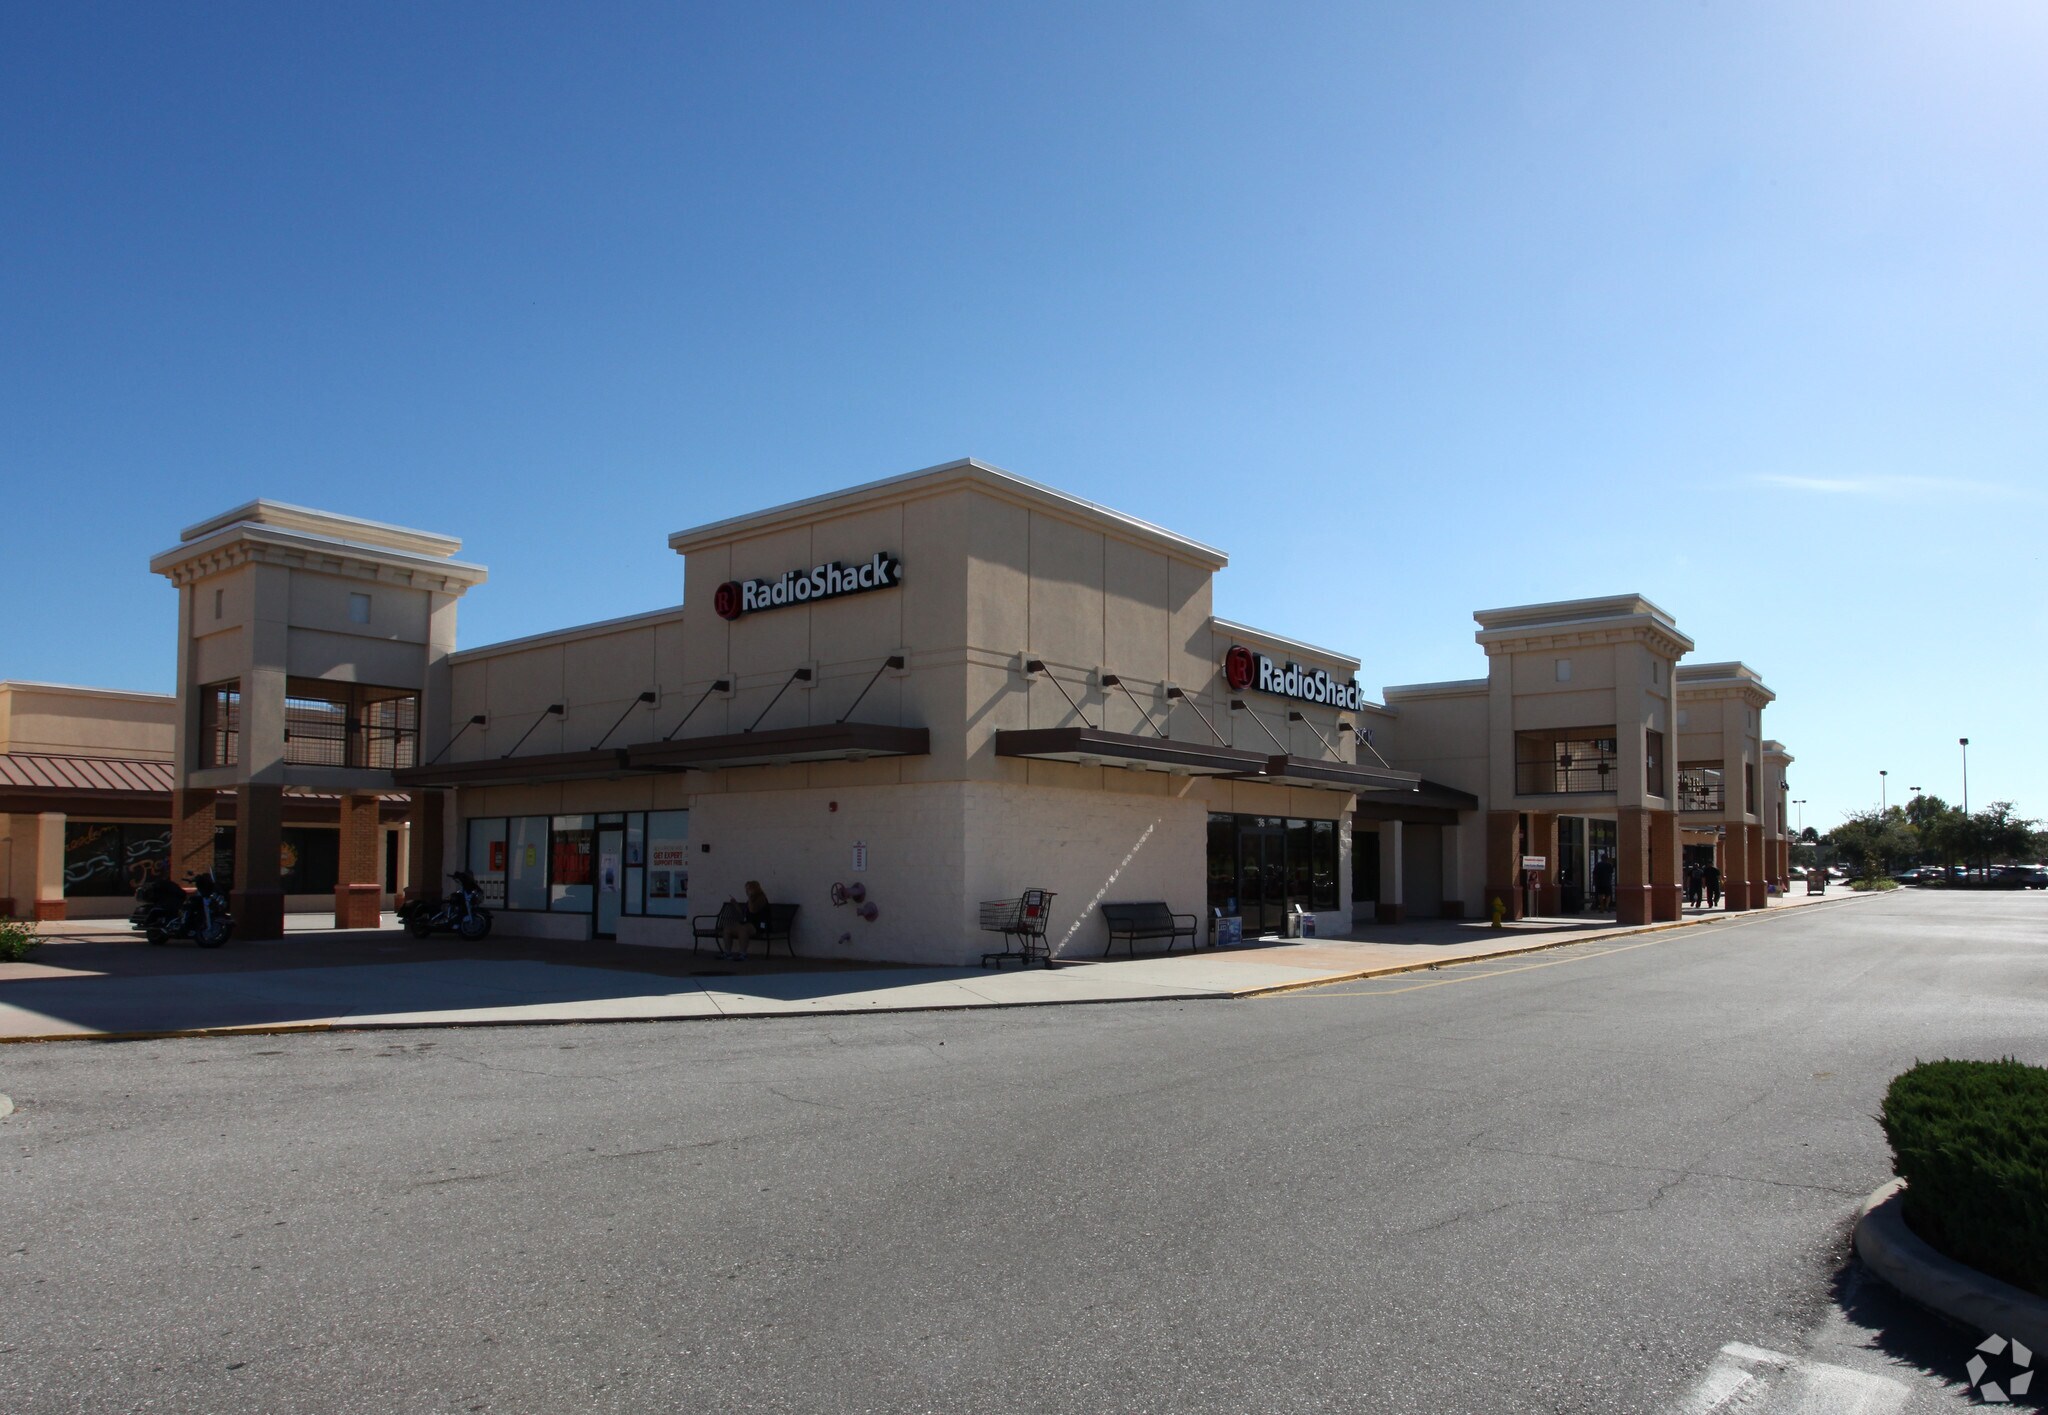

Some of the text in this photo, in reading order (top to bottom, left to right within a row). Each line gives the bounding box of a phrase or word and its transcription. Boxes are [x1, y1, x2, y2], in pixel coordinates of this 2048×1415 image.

[742, 552, 889, 611] RadioShack
[1259, 655, 1365, 711] RadioShack
[653, 851, 683, 860] GET EXPERT
